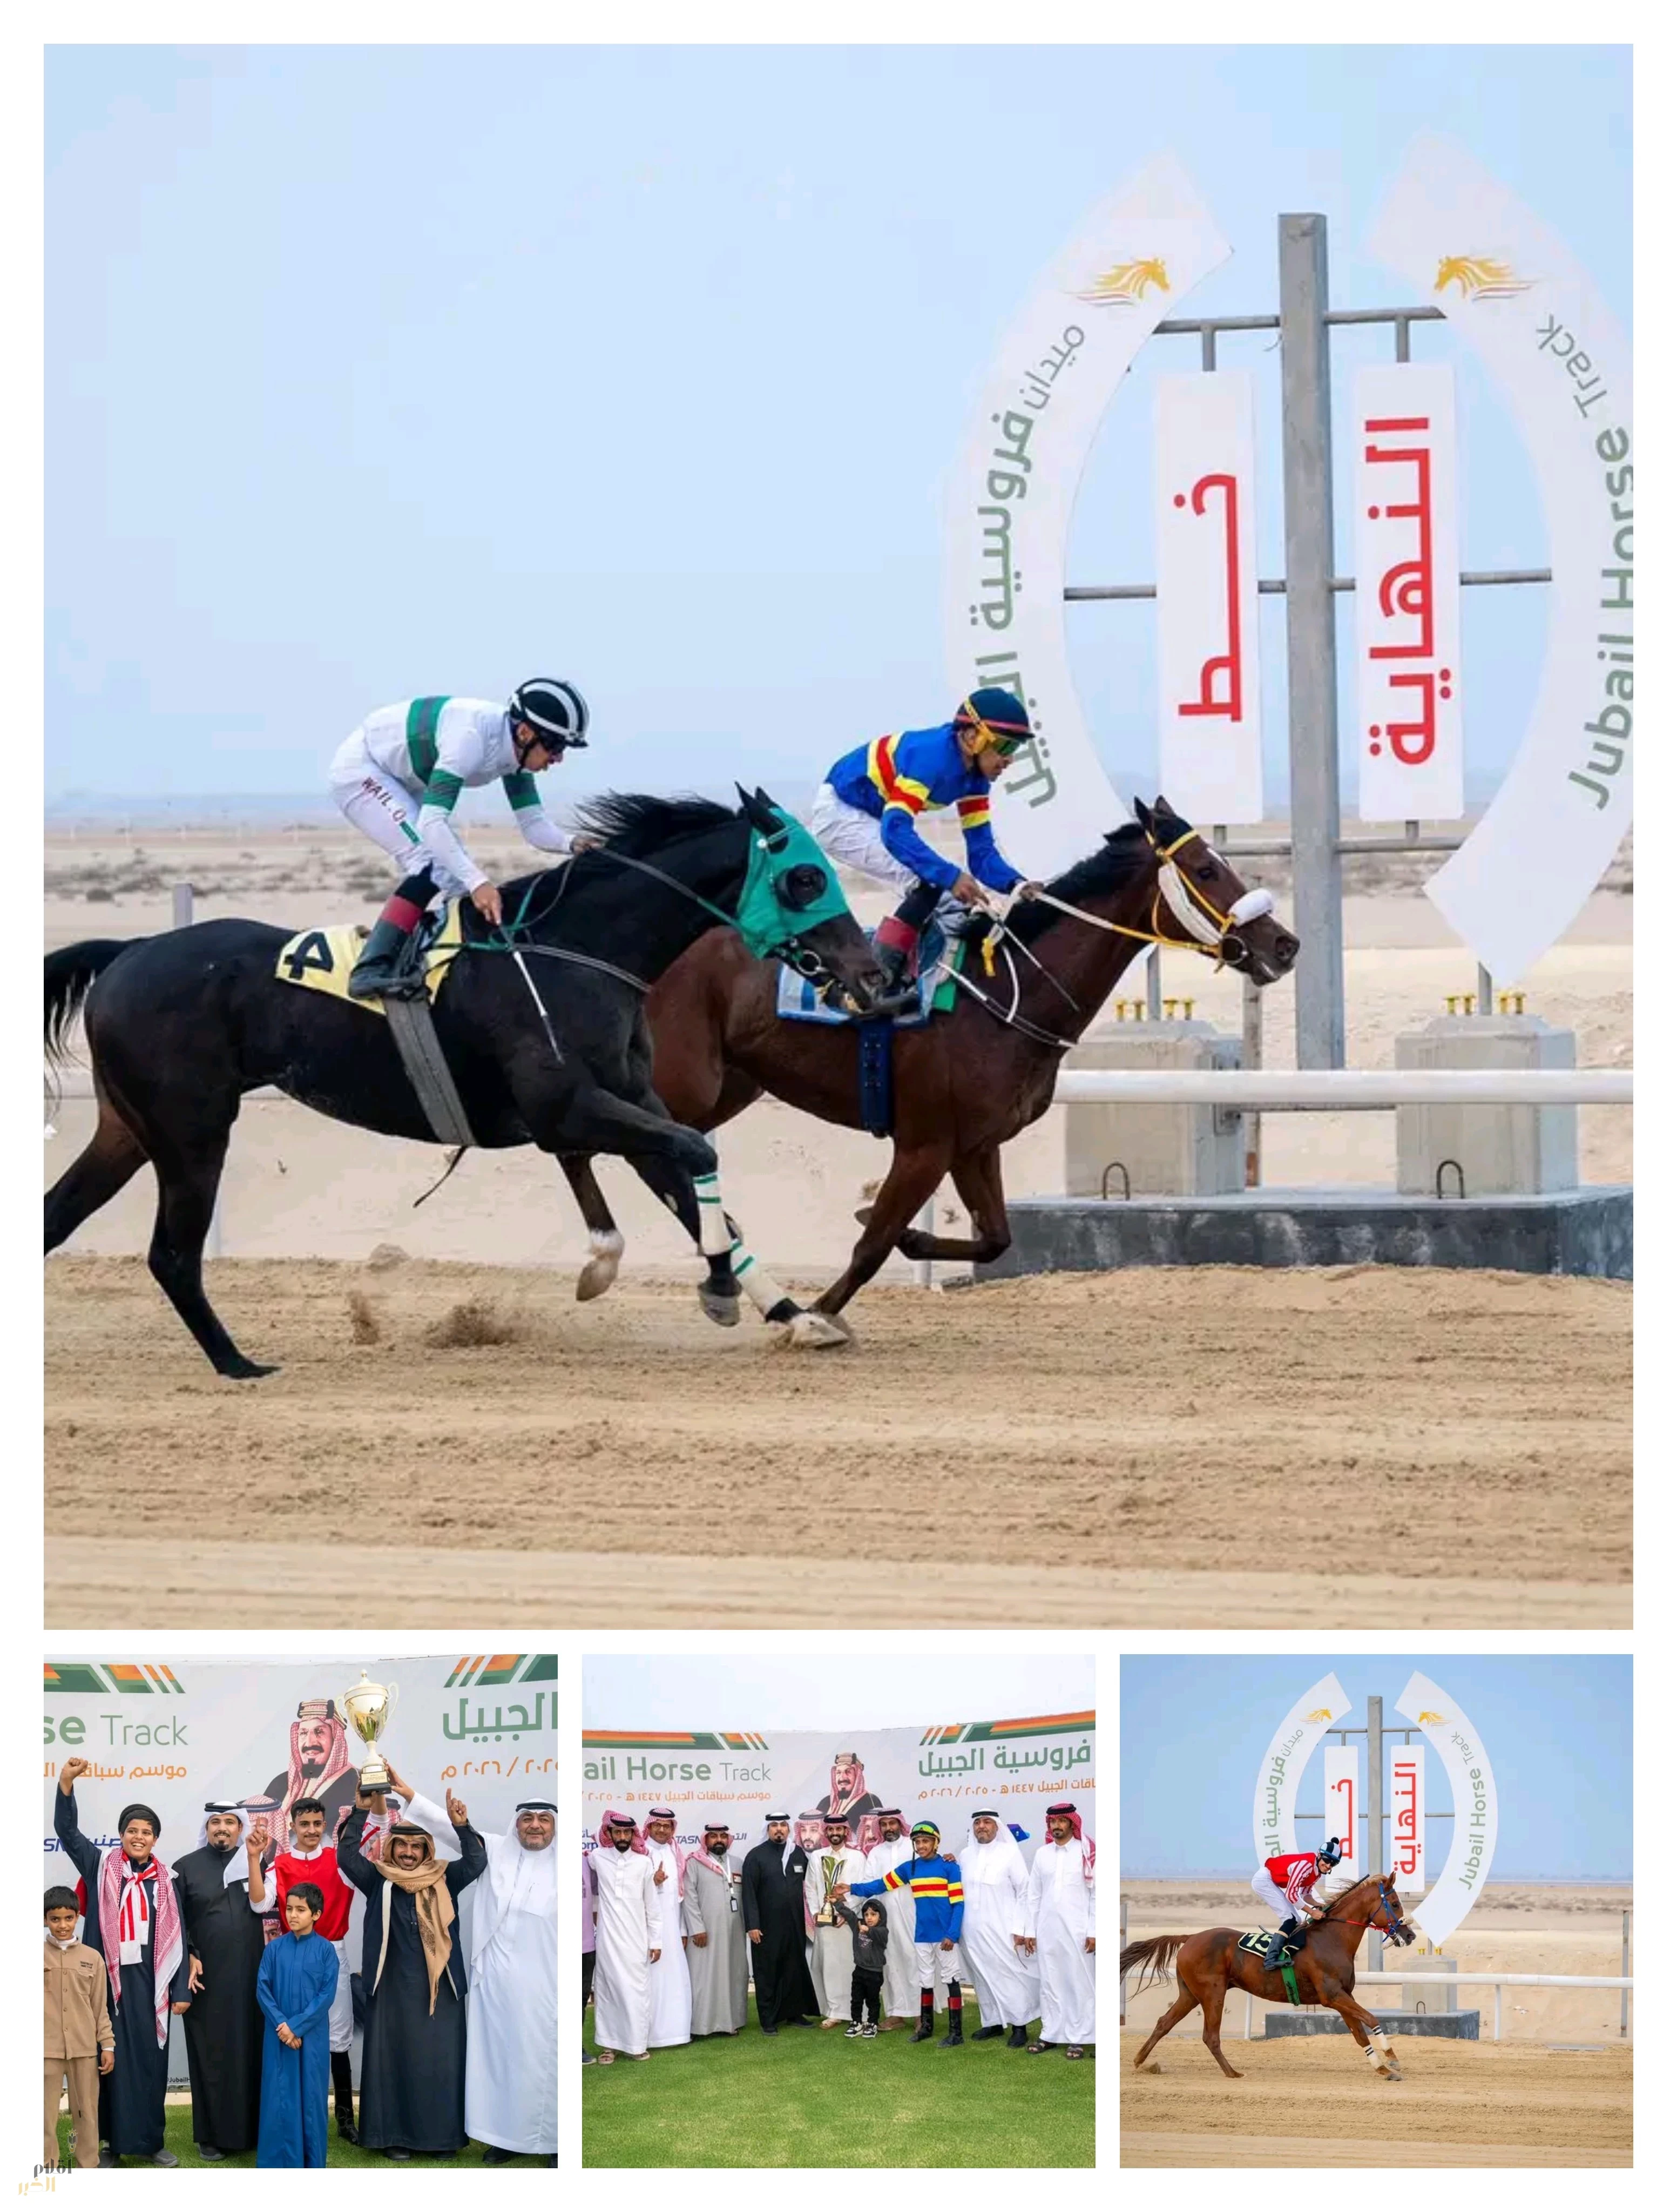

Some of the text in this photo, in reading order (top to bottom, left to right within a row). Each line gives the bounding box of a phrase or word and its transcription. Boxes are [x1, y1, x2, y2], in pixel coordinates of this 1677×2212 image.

[1022, 325, 1084, 409] ميدان
[1536, 315, 1607, 419] Track
[970, 409, 1034, 631] فروسية
[1173, 474, 1242, 722] خط
[1364, 417, 1451, 765] النهاية
[1568, 633, 1634, 810] Jubail
[283, 931, 334, 981] 4
[443, 1691, 558, 1743] الجبيل
[100, 1715, 189, 1746] Track
[1281, 1729, 1303, 1756] ميدان
[464, 1761, 501, 1776] ٢٠٢٦
[584, 1756, 772, 1782] ail Horse Track
[919, 1738, 1091, 1778] فروسية الجبيل
[129, 1764, 187, 1779] موسم
[441, 1765, 457, 1781] م
[1071, 1777, 1096, 1789] اقات
[588, 1792, 613, 1801] ٢٠٢٥
[638, 1792, 661, 1800] ١٤٤٧
[665, 1791, 694, 1802] الجبيل
[697, 1790, 734, 1802] سباقات
[737, 1791, 771, 1801] موسم
[931, 1789, 952, 1797] ٢٠٢٦
[966, 1786, 988, 1796] ٢٠٢٥
[1012, 1784, 1034, 1793] ١٤٤٧
[1038, 1779, 1067, 1793] الجبيل
[1262, 1756, 1286, 1827] فروسية
[1394, 1763, 1422, 1874] النهاية
[1451, 1731, 1486, 1890] Jubail Horse Track
[676, 1835, 700, 1844] TASN
